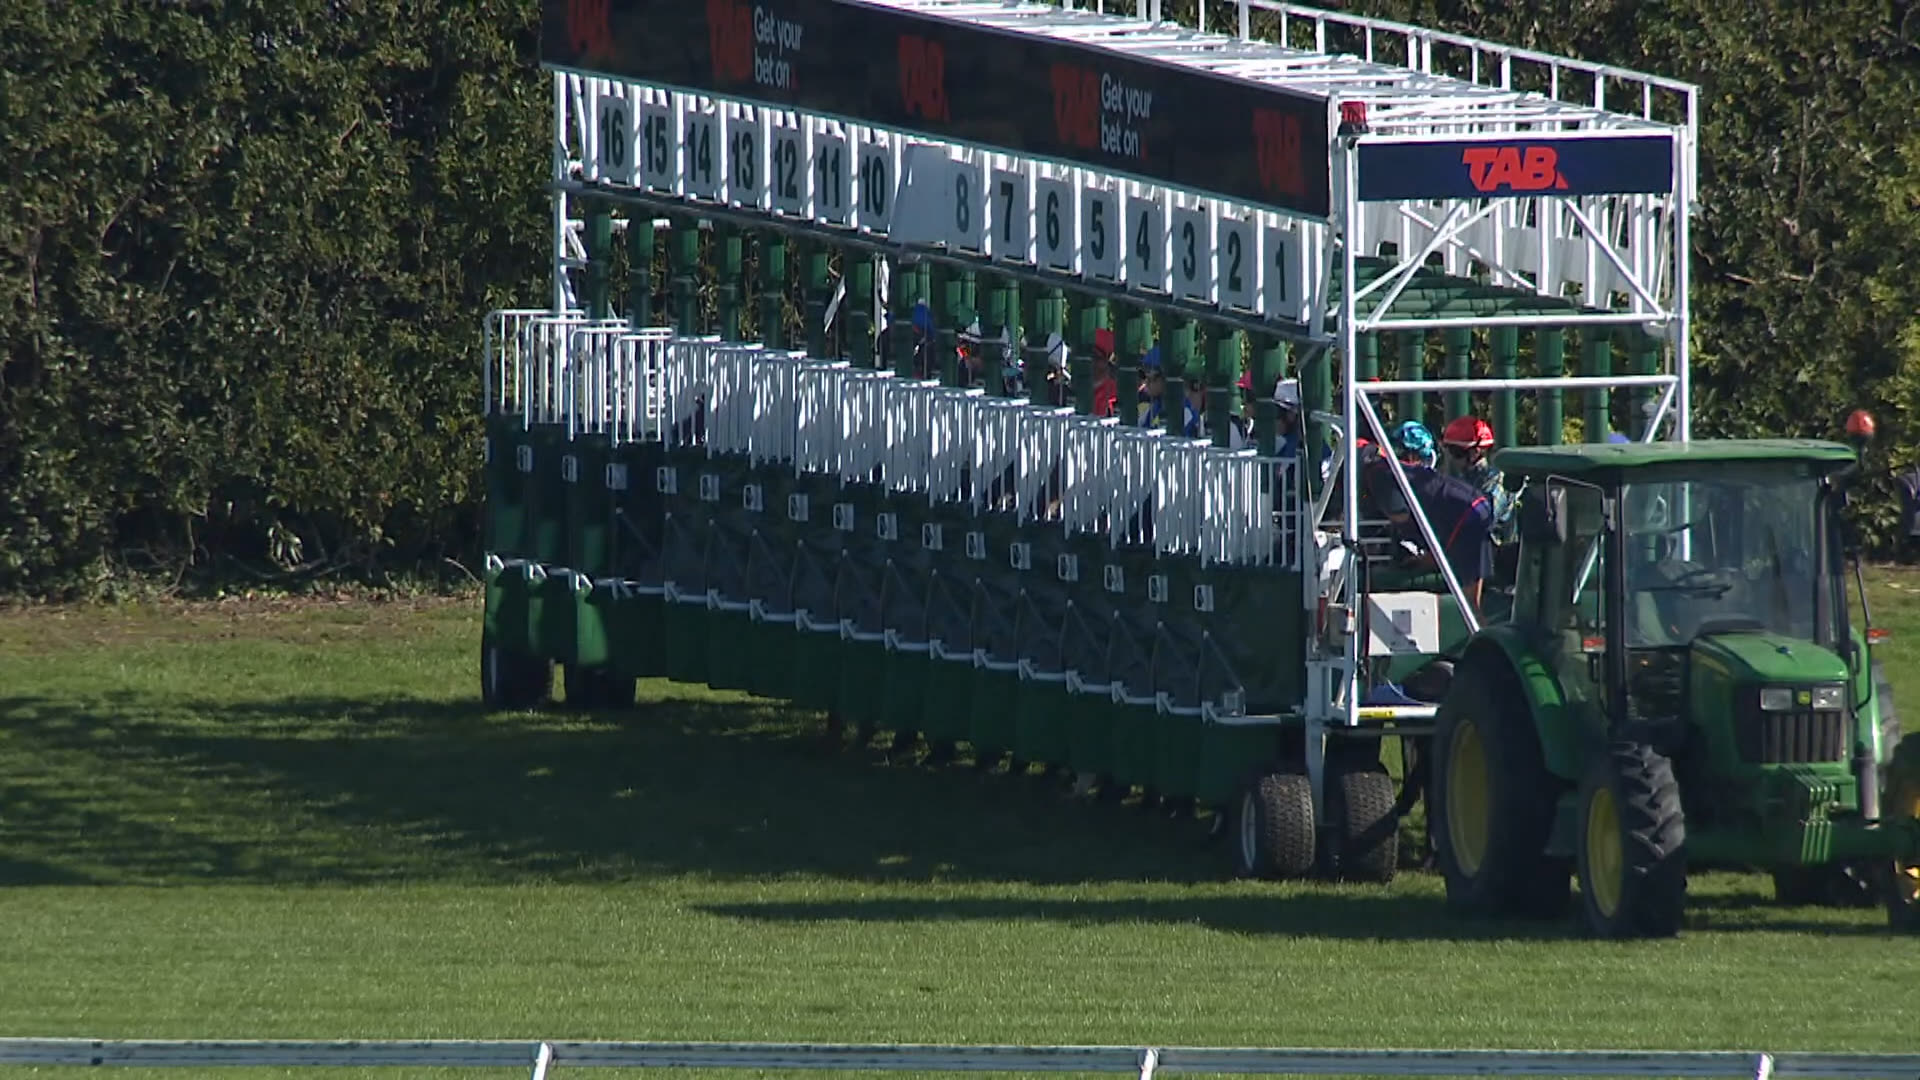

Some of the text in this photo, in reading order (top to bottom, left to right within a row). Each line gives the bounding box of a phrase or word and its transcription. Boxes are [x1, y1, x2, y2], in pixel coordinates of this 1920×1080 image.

[754, 6, 802, 57] Get your
[754, 47, 790, 89] bet on
[1101, 72, 1153, 123] Get your
[601, 109, 625, 168] 16
[641, 115, 668, 176] 15
[687, 122, 712, 184] 14
[732, 131, 755, 191] 13
[1101, 114, 1140, 158] bet on
[774, 138, 799, 200] 12
[818, 145, 841, 209] 11
[861, 155, 886, 217] 10
[1462, 146, 1563, 191] TAB
[955, 173, 970, 233] 8
[1000, 182, 1014, 243] 7
[1046, 190, 1060, 251] 6
[1090, 200, 1105, 261] 5
[1135, 210, 1151, 272] 4
[1182, 220, 1196, 281] 3
[1227, 231, 1242, 292] 2
[1275, 241, 1286, 302] 1
